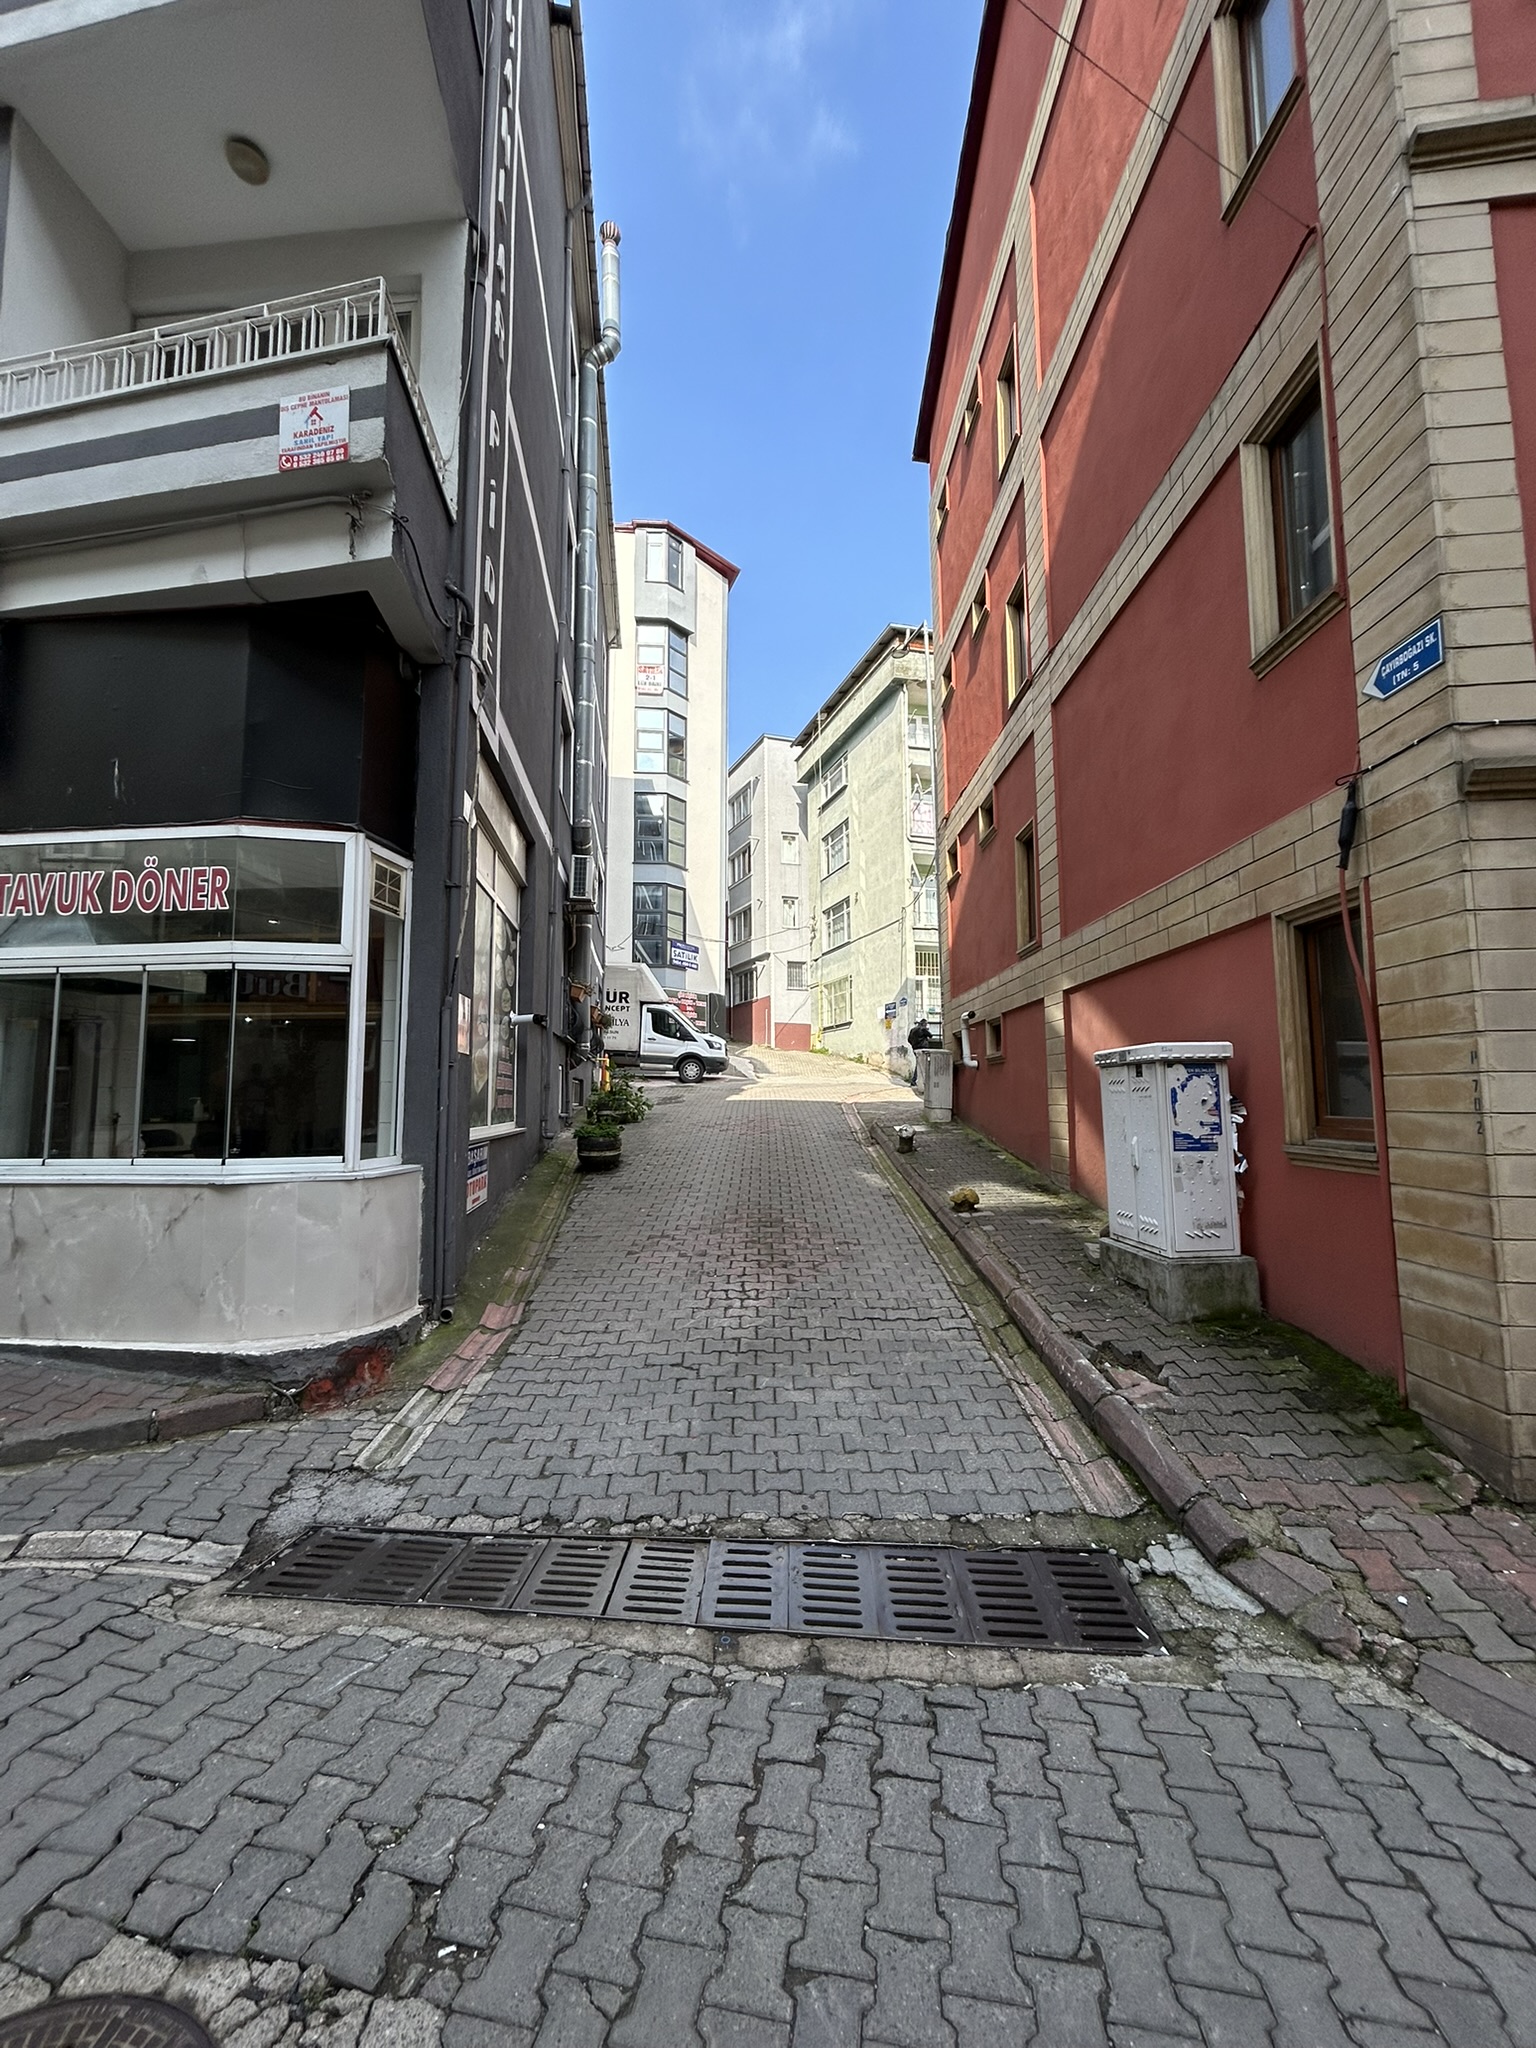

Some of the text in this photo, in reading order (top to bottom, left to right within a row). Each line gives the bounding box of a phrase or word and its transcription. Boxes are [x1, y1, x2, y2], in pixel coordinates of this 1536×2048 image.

[294, 425, 334, 438] KARADENİZ
[1381, 632, 1437, 679] ÇAYIRBOĞAZI SK.
[1412, 660, 1420, 672] 5
[109, 856, 230, 914] DÖNER
[673, 950, 698, 961] SATILIK
